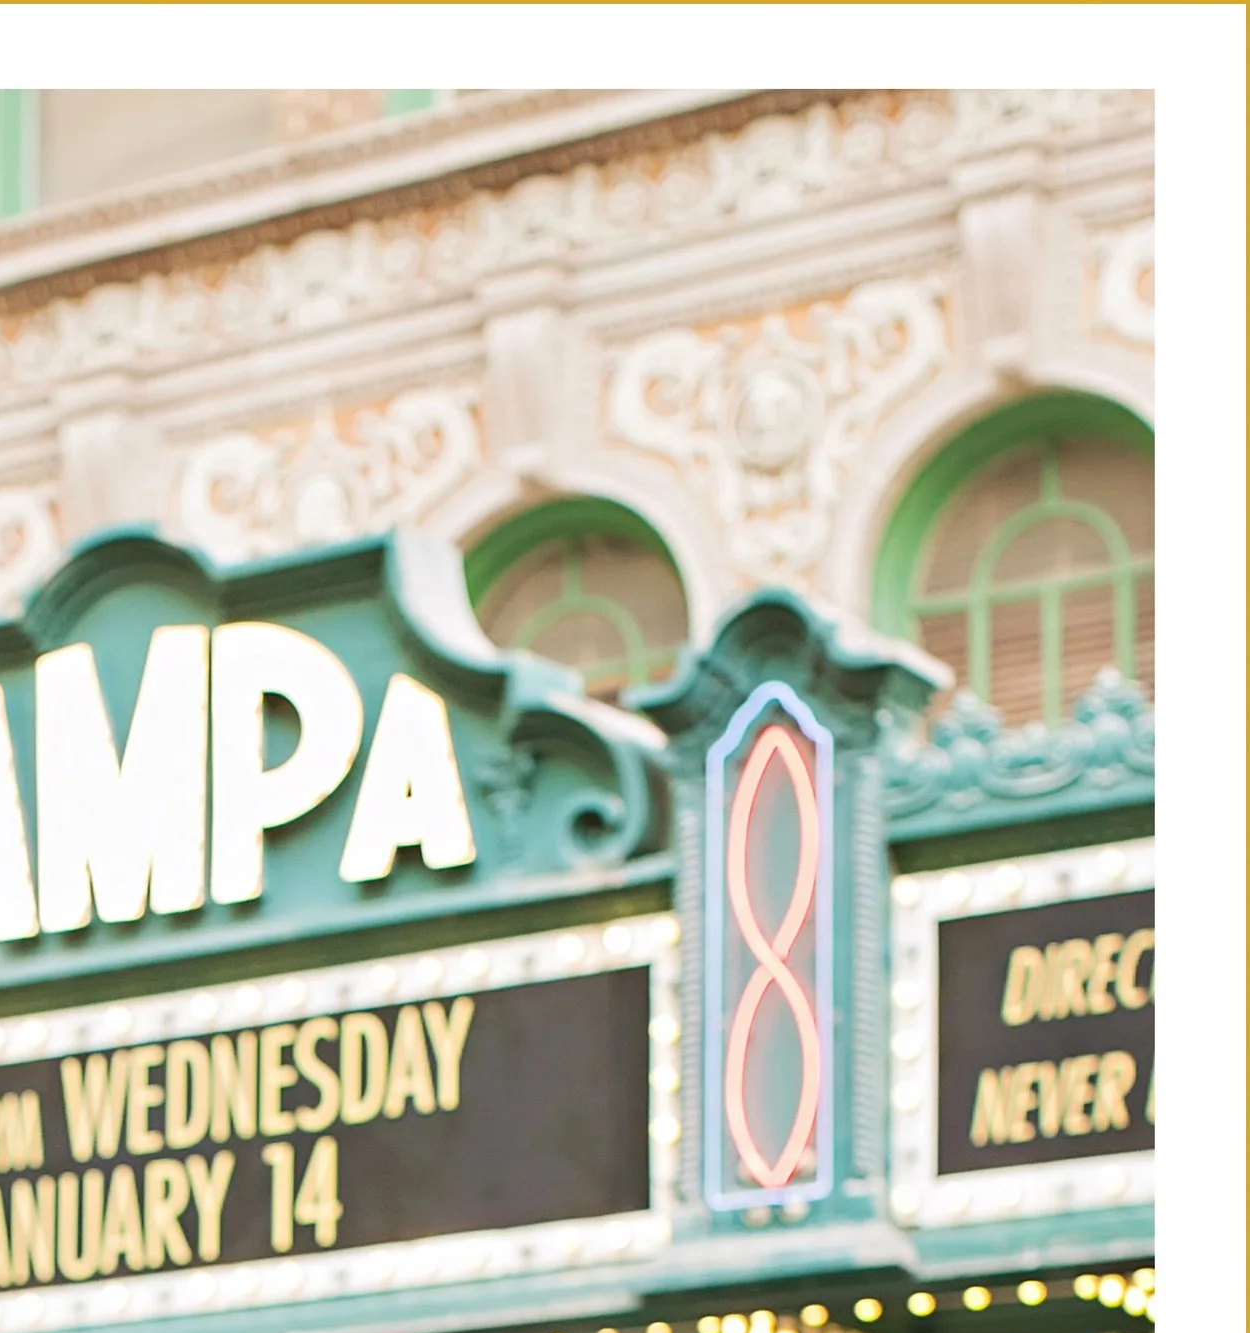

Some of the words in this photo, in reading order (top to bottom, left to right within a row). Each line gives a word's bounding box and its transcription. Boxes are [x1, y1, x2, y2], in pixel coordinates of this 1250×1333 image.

[1001, 928, 1155, 1027] DIREC
[60, 997, 475, 1163] WEDNESDAY
[969, 1050, 1137, 1148] NEVER
[263, 1134, 342, 1252] 14
